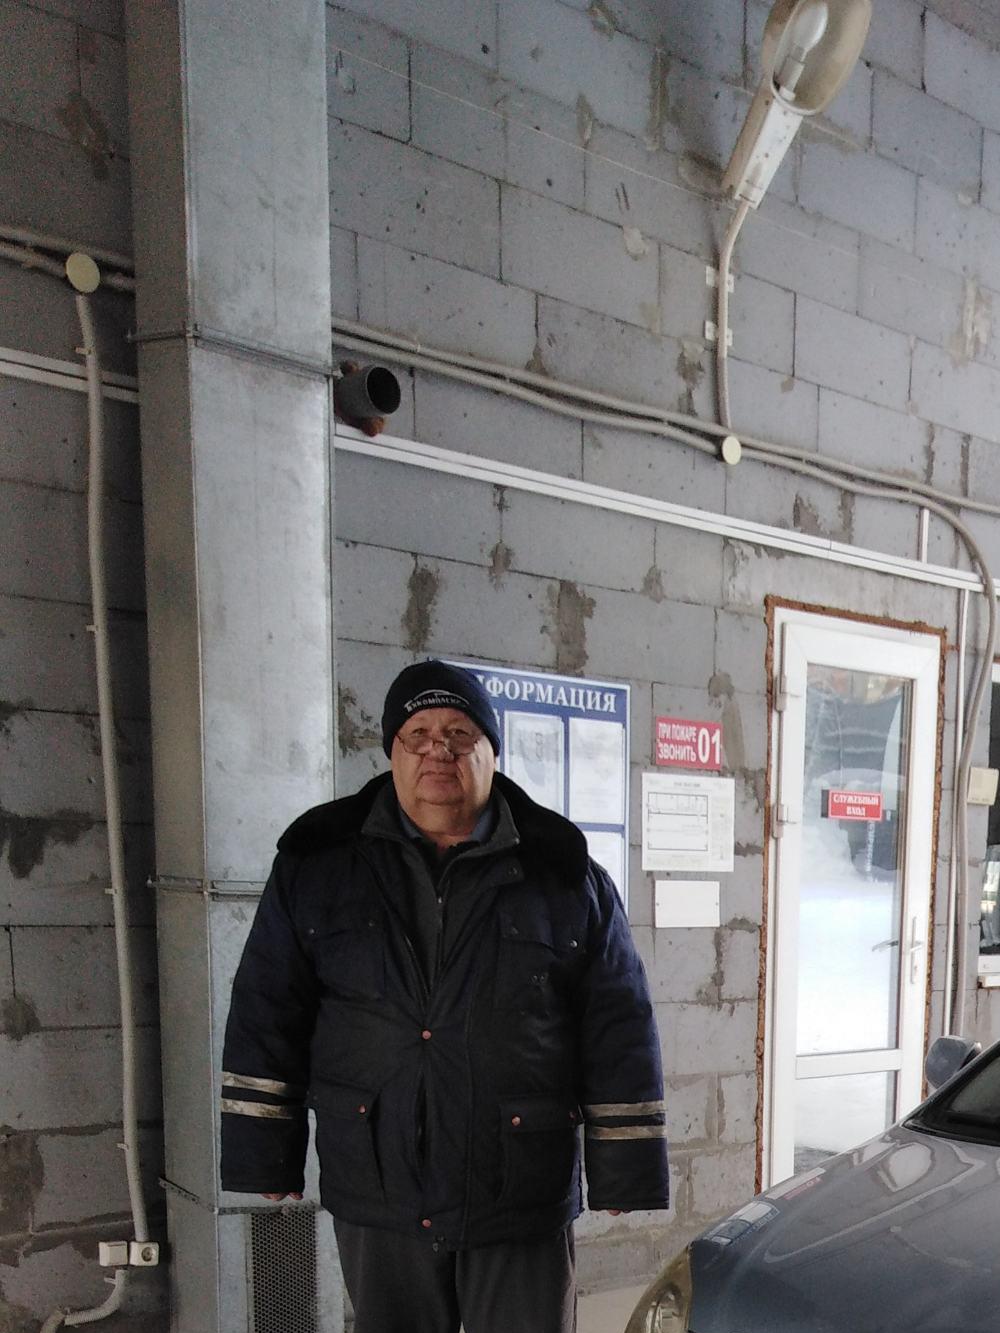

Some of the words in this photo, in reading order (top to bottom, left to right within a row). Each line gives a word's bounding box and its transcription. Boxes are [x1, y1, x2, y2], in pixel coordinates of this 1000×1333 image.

[477, 675, 616, 713] ФОРМАЦИЯ
[659, 722, 671, 739] ПРИ
[672, 723, 697, 742] ПОЖАРЕ
[697, 727, 721, 765] 01
[658, 742, 697, 762] ЗВОНИТЬ
